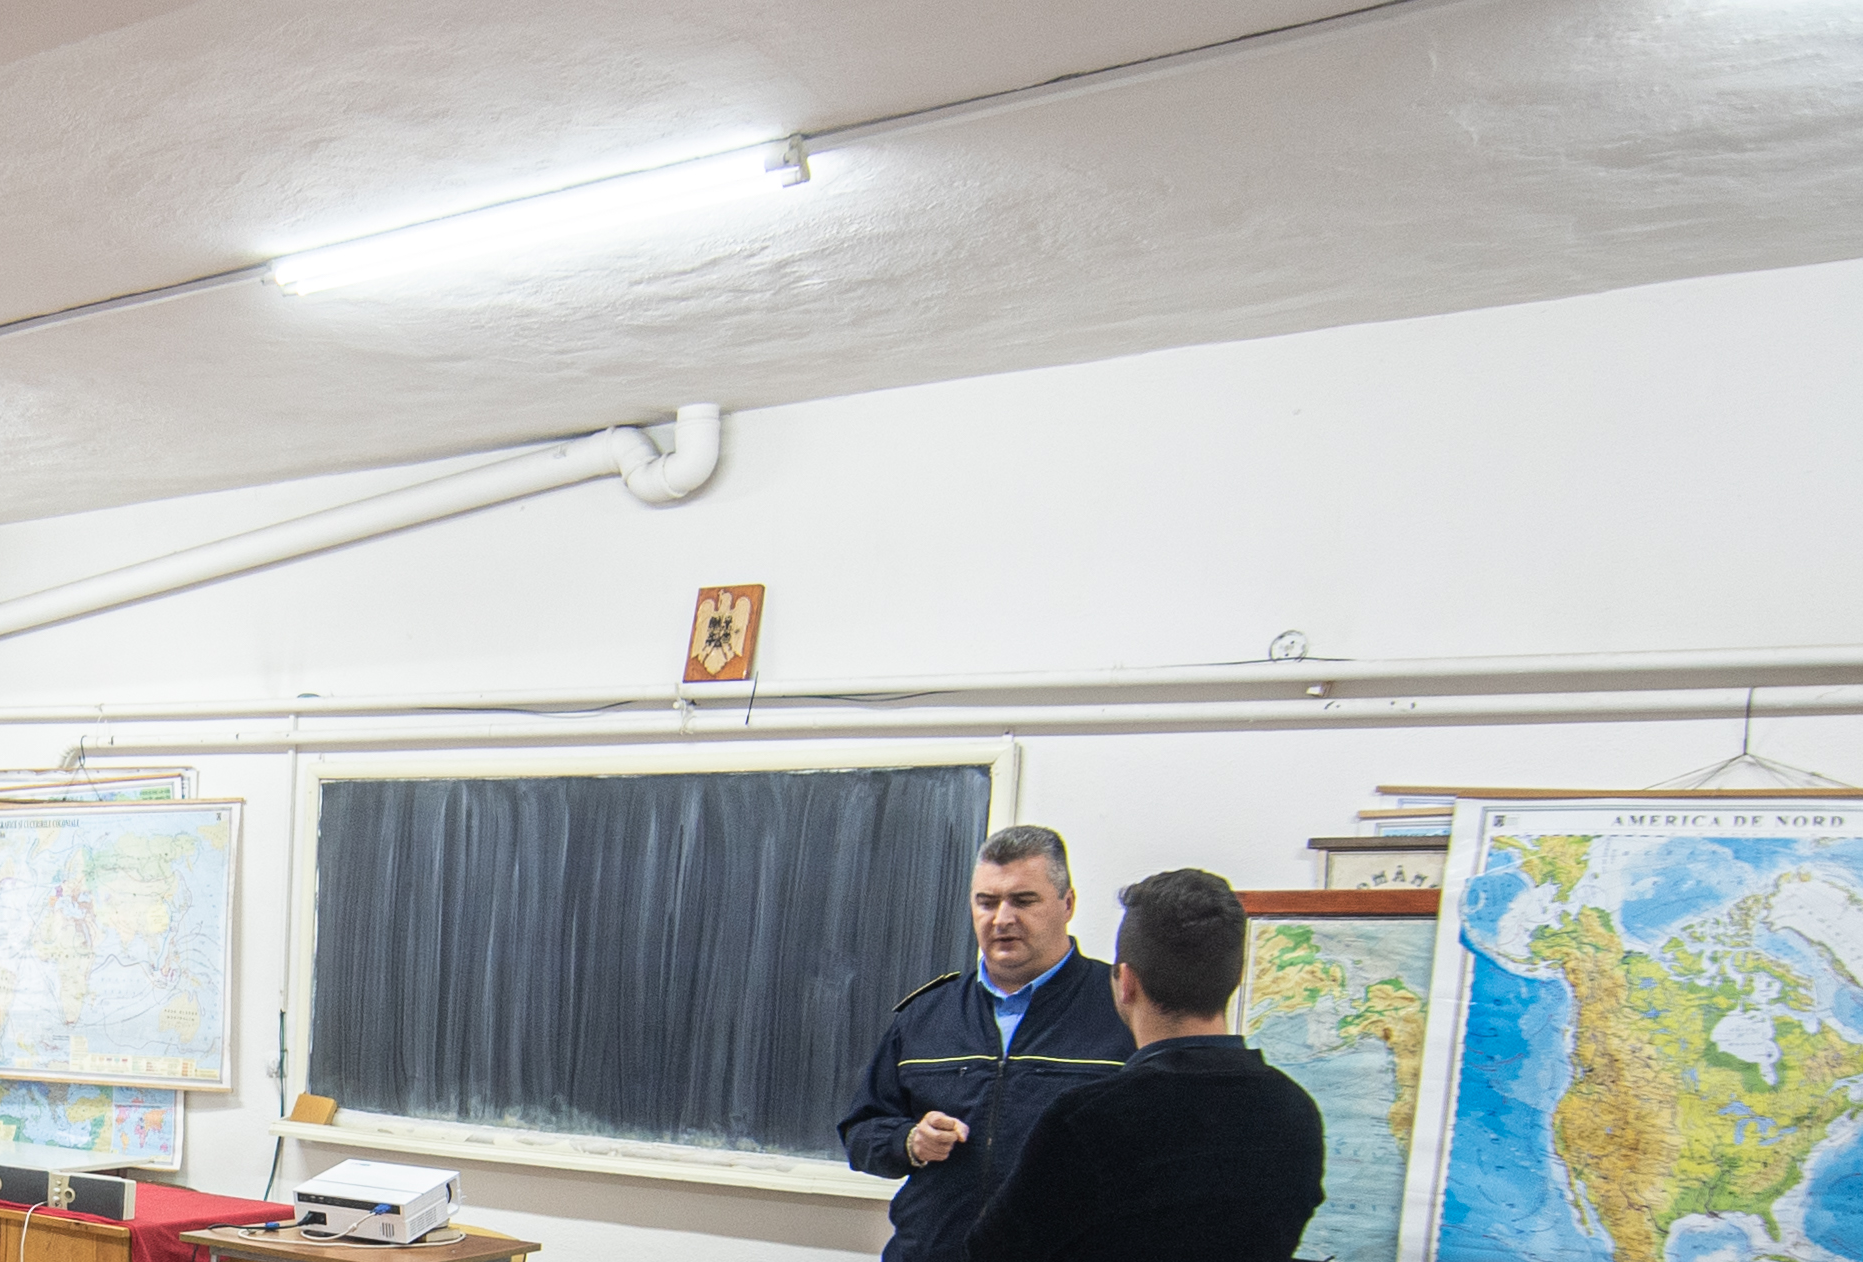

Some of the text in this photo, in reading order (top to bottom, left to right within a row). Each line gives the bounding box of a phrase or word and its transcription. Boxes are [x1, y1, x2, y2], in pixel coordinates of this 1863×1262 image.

[1611, 815, 1845, 828] AMERICA DE NORD
